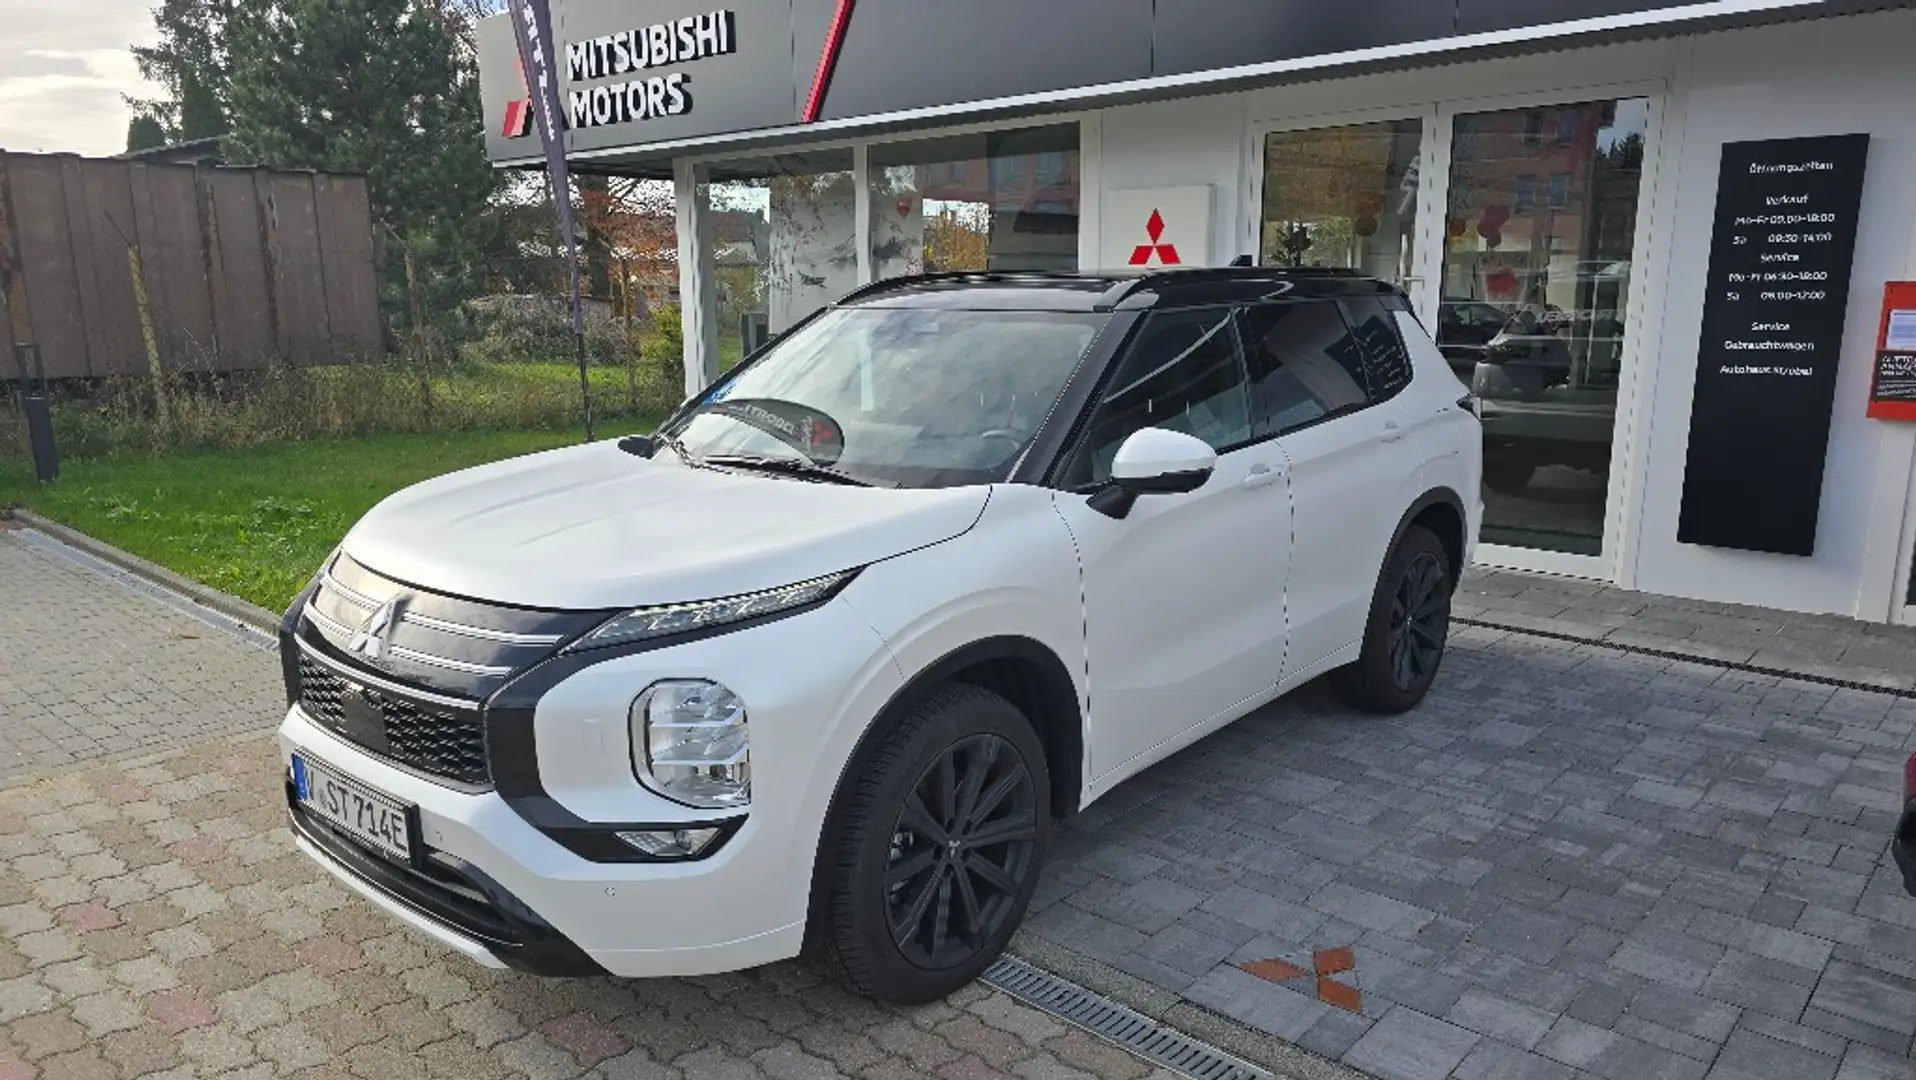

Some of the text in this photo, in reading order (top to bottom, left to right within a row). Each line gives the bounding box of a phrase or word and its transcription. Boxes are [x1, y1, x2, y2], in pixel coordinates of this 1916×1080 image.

[566, 9, 733, 81] MITSUBISHI
[568, 73, 690, 129] MOTORS
[1760, 252, 1800, 264] Service
[1750, 321, 1791, 332] Service
[1723, 340, 1815, 354] Gebrauchtwagen
[1719, 364, 1771, 375] Autohaus
